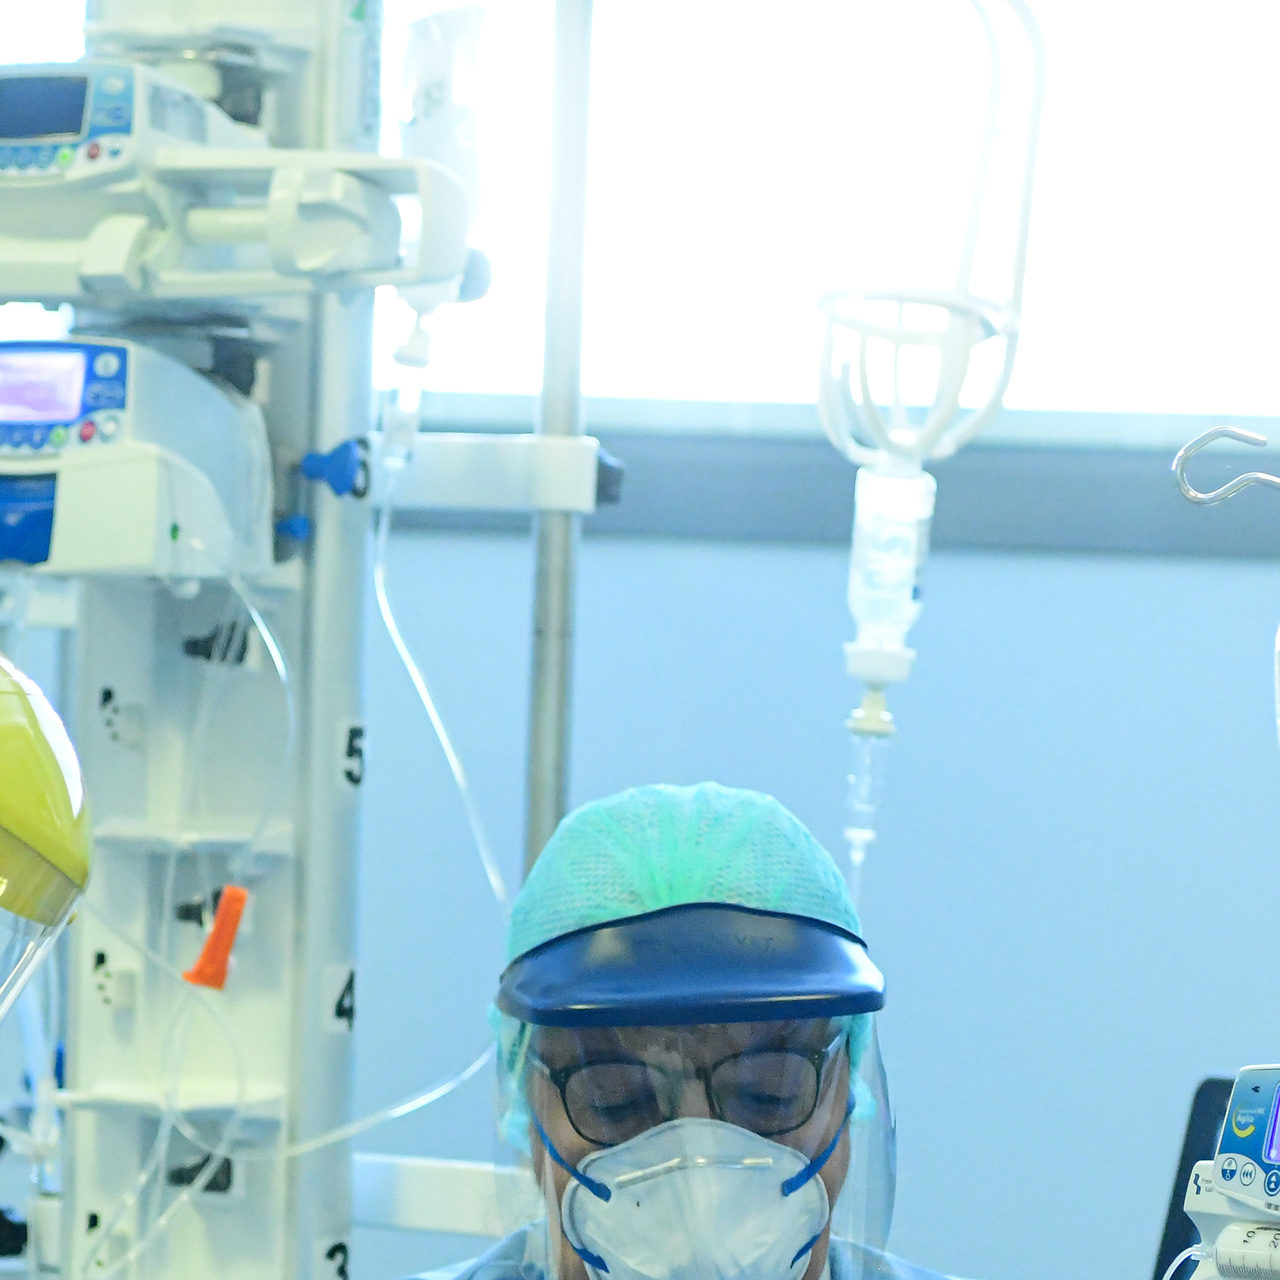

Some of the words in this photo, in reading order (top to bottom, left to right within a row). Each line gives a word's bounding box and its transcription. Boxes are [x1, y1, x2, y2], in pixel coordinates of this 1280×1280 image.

[345, 727, 364, 785] 5
[335, 969, 354, 1031] 4
[1243, 1230, 1256, 1244] 10
